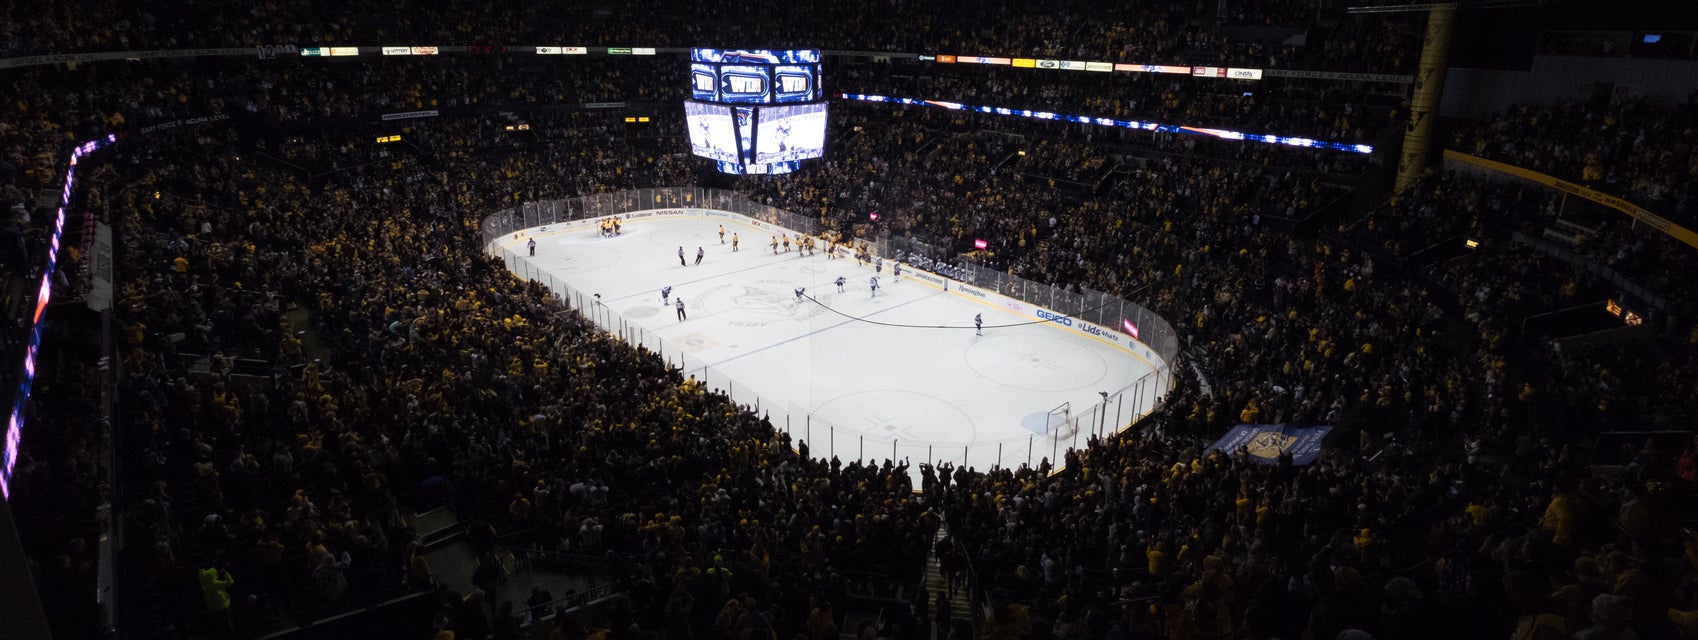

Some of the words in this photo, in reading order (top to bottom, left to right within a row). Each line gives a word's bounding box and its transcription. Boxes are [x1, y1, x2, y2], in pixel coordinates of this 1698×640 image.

[729, 76, 762, 93] WIN
[781, 76, 806, 92] WIN
[186, 116, 208, 125] ACURA
[1036, 309, 1072, 326] GEICO
